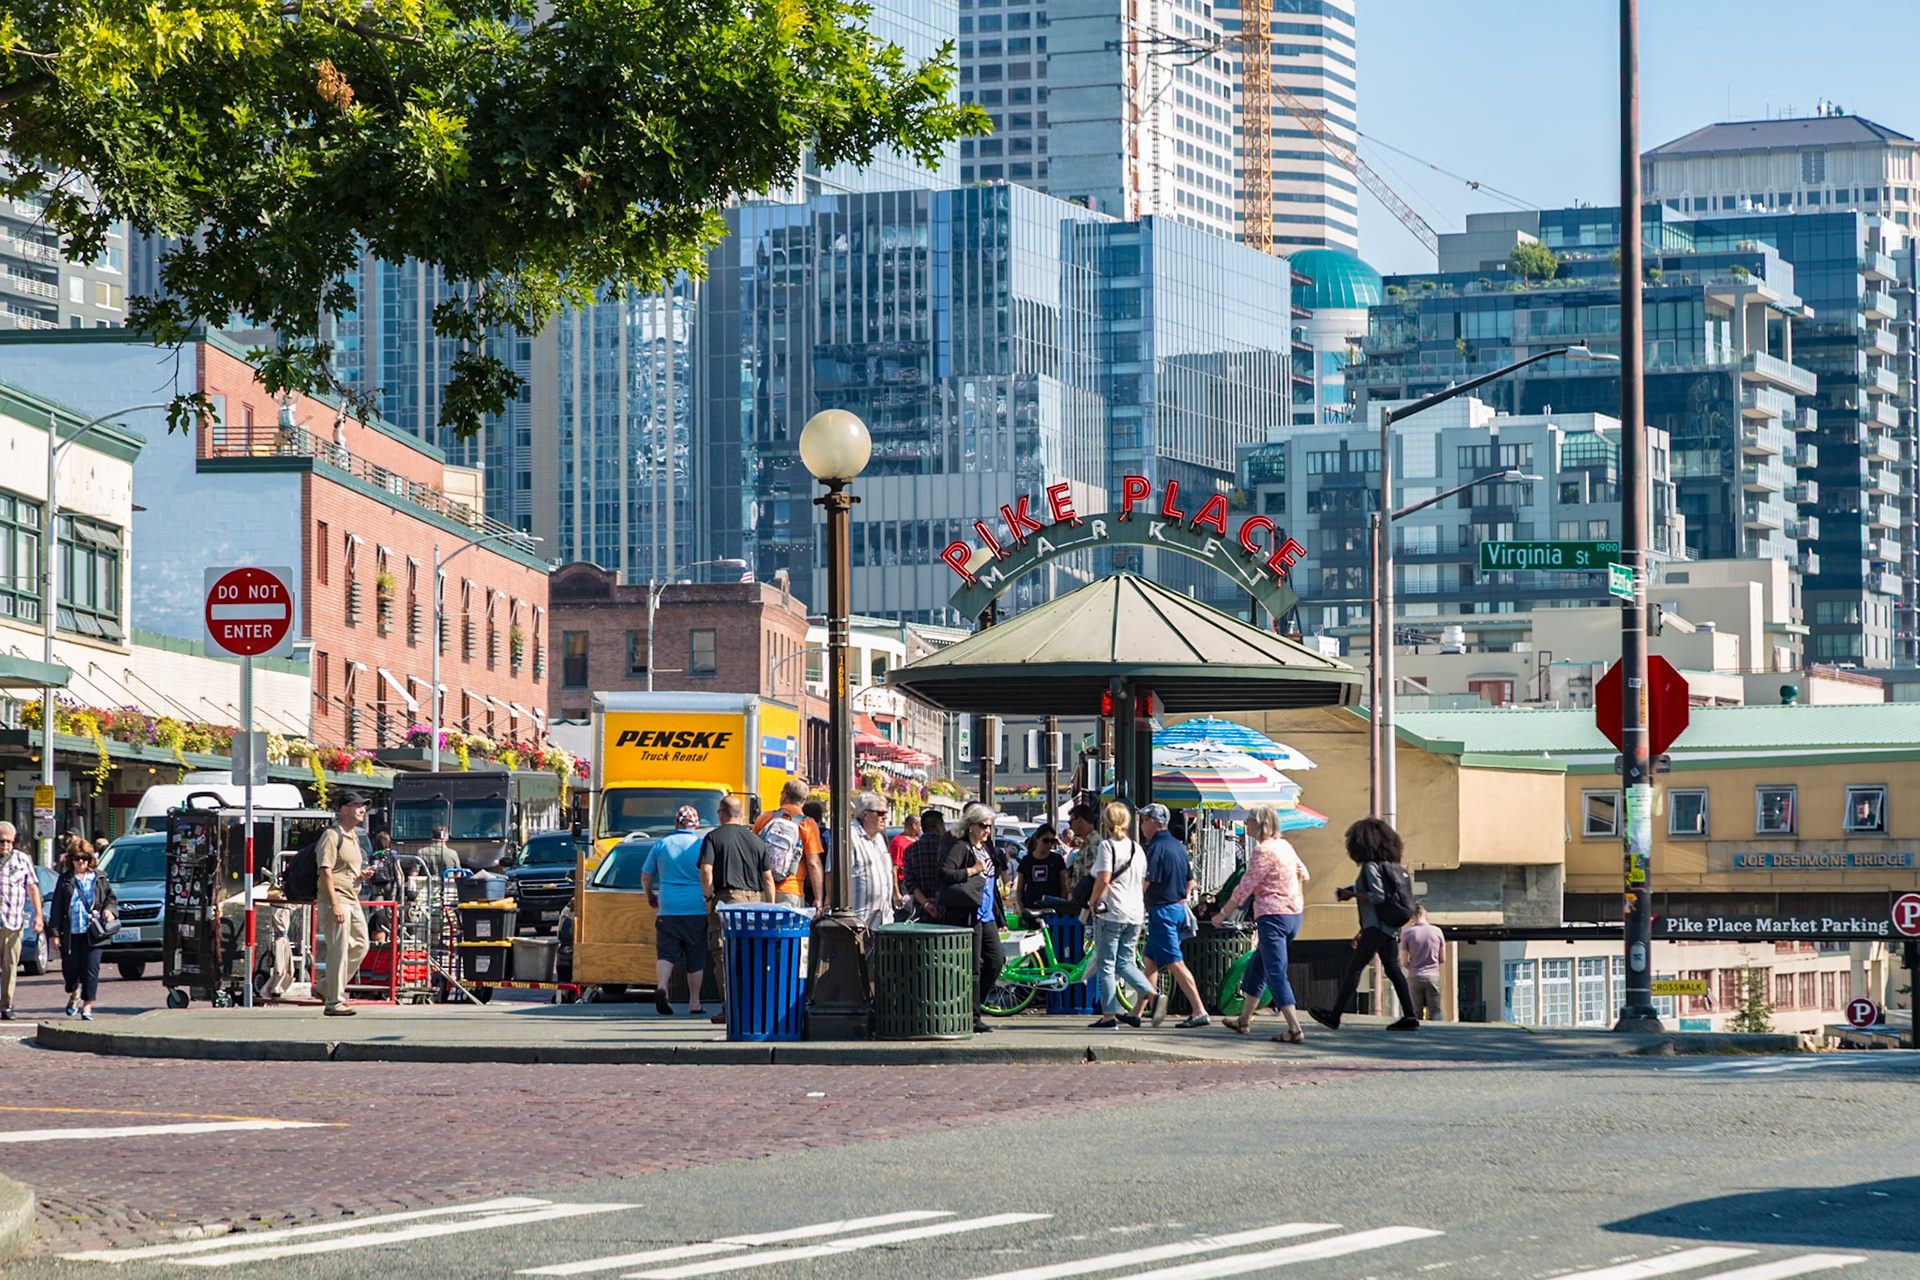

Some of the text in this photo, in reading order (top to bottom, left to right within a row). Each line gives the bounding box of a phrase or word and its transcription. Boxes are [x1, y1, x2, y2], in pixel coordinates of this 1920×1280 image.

[940, 475, 1307, 582] PIKE PLACE
[978, 519, 1269, 590] MARKET
[1487, 543, 1618, 569] Virginia St 1900
[218, 584, 279, 599] DO NOT
[224, 624, 273, 639] ENTER
[615, 730, 733, 749] PENSKE
[640, 751, 709, 762] Truck Rental
[1739, 854, 1905, 867] JOE DESIMONE BRIDGE
[1901, 902, 1920, 928] P
[1666, 917, 1889, 936] Pike Place Market Parking
[1651, 983, 1702, 992] CROSSWALK
[1853, 1003, 1872, 1023] P
